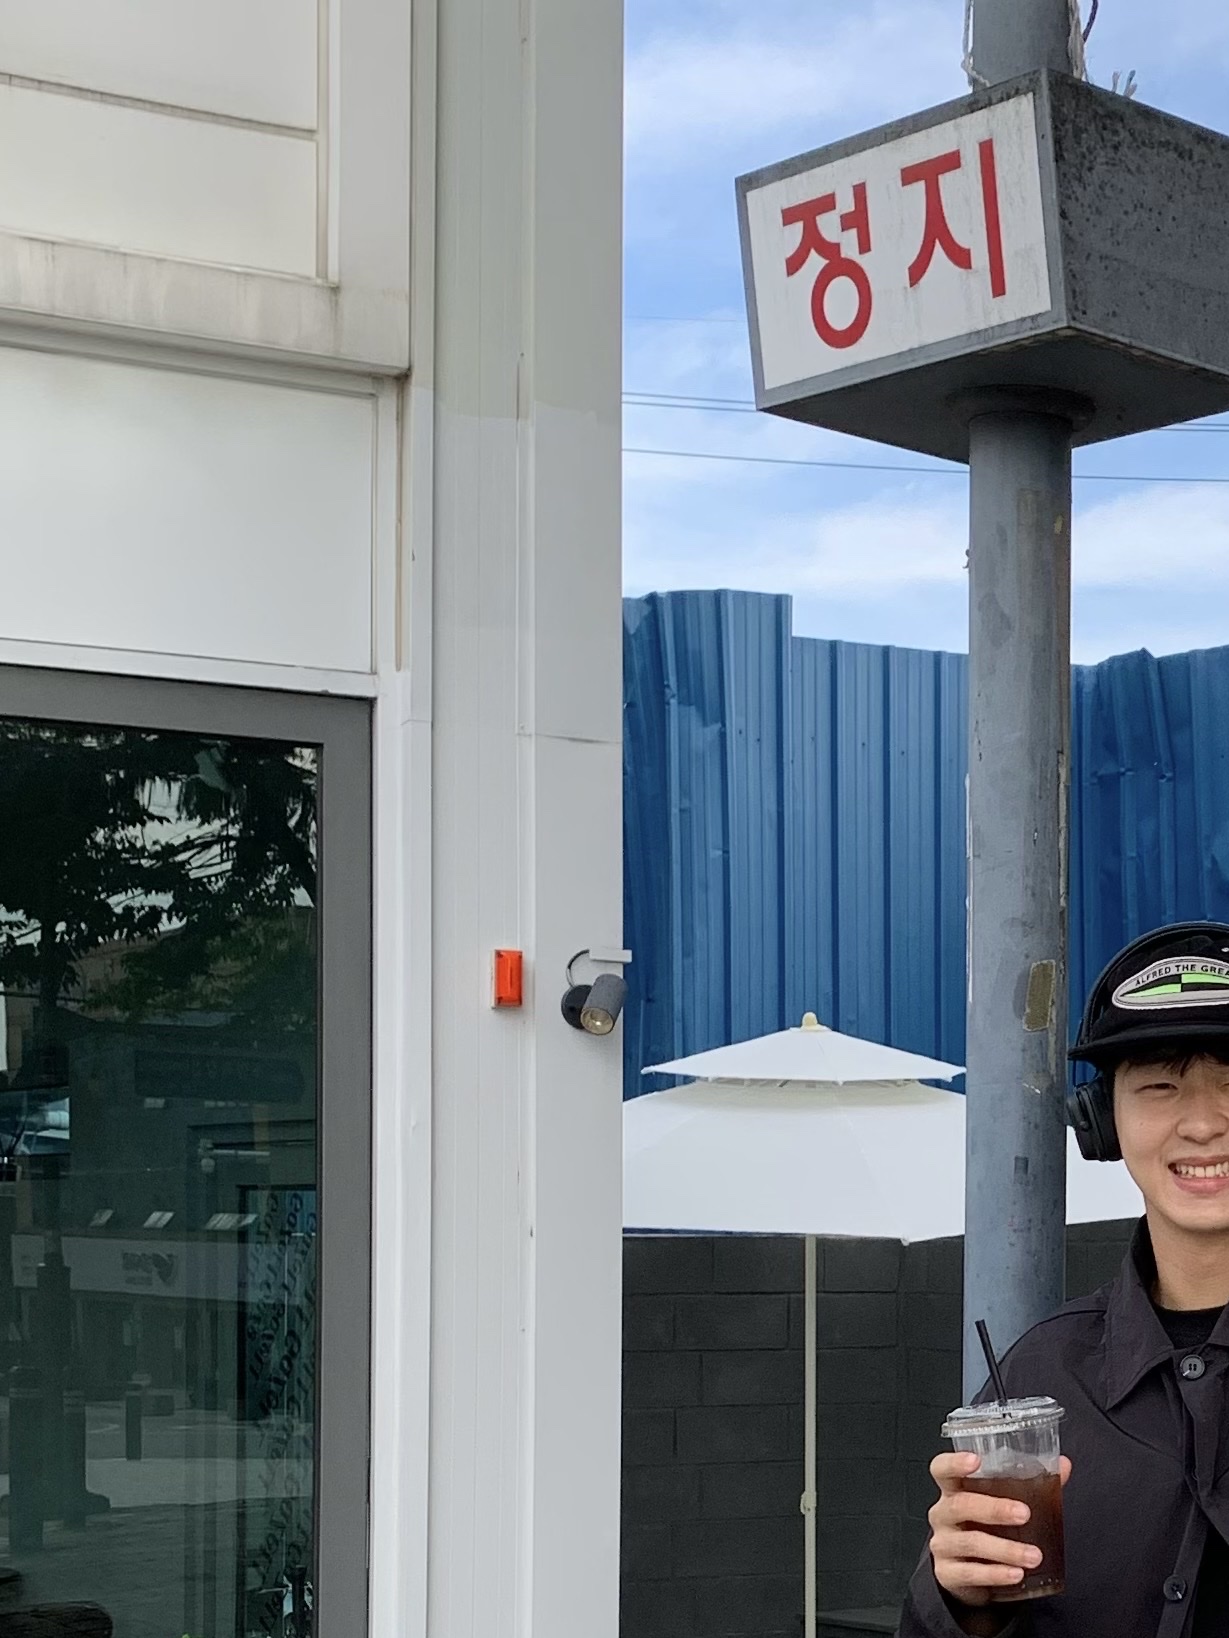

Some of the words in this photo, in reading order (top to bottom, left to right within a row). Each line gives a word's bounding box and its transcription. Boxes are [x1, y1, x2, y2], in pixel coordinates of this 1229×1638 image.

[780, 137, 1007, 349] 정지
[1135, 966, 1171, 986] ALFRED
[1174, 964, 1197, 972] THE
